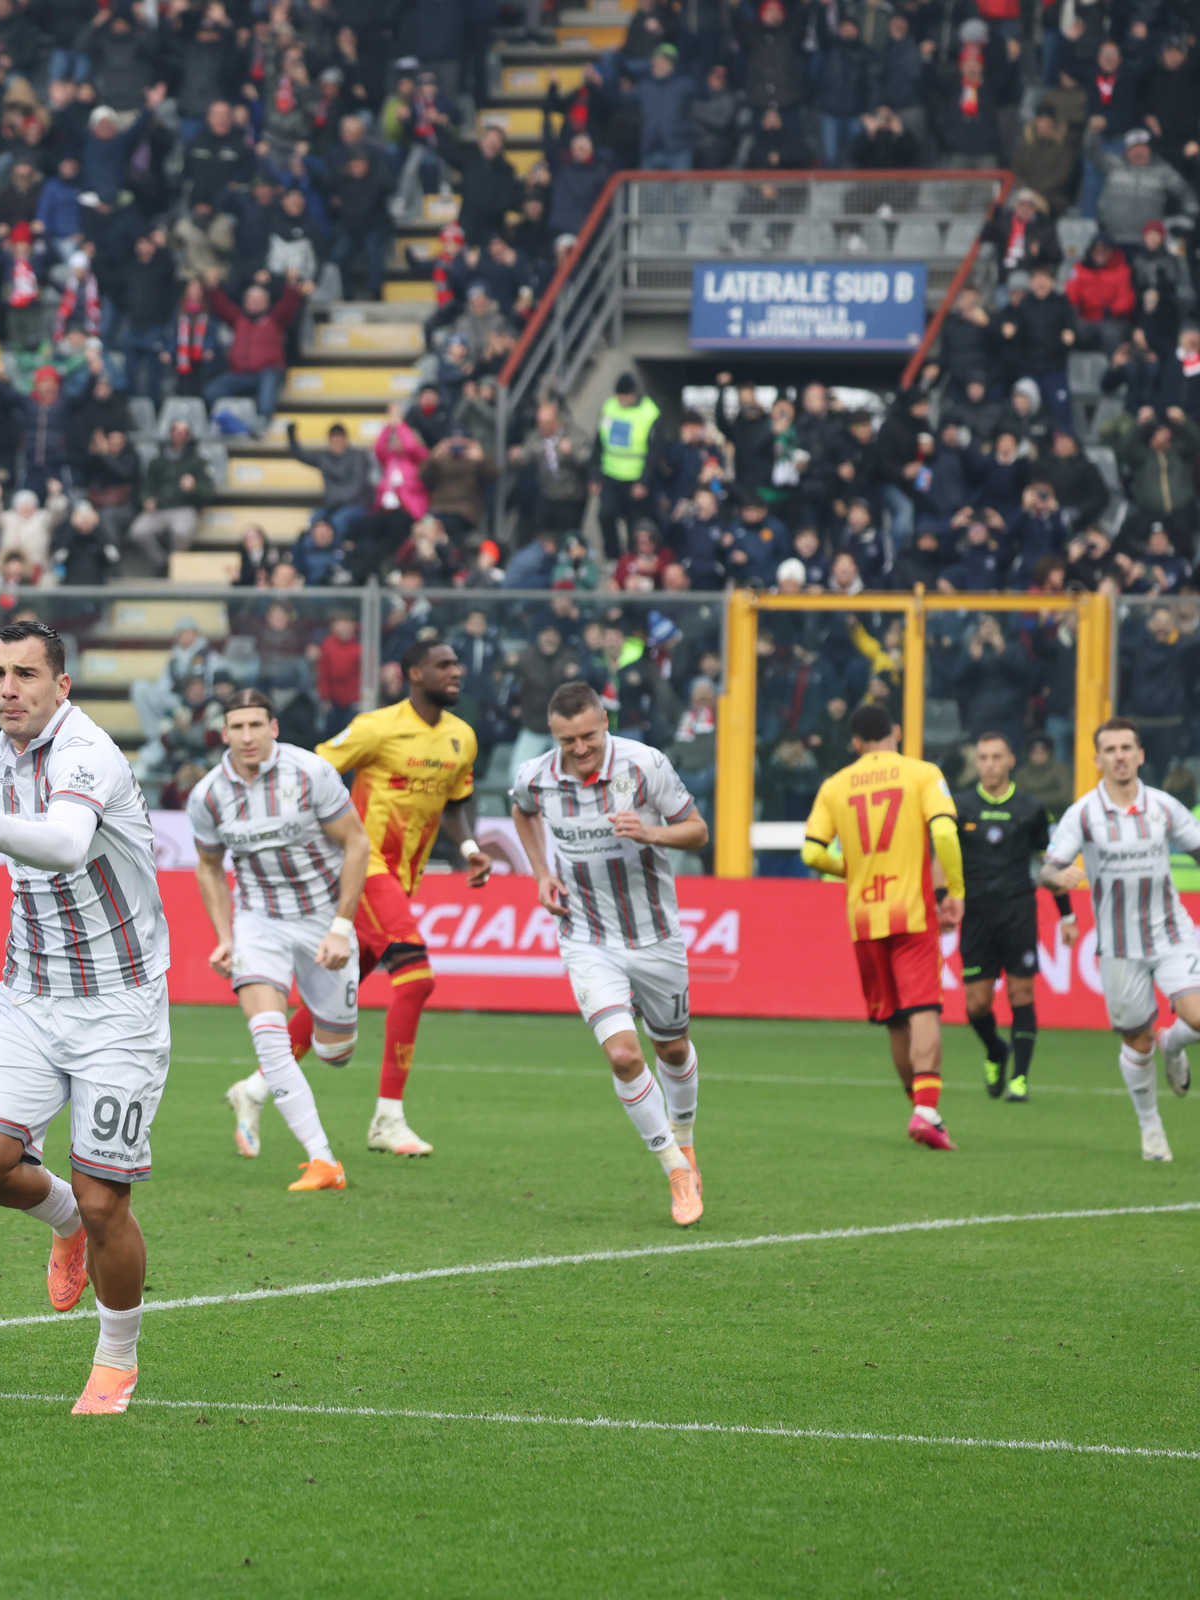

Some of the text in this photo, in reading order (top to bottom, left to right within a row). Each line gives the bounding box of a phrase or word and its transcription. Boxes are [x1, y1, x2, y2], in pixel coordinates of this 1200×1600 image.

[703, 270, 914, 303] LATERALE SUD B
[850, 766, 900, 788] DANILO
[848, 786, 904, 856] 17
[861, 874, 898, 903] dr
[411, 898, 558, 950] CIAR
[345, 980, 356, 1008] 6
[91, 1095, 143, 1147] 90
